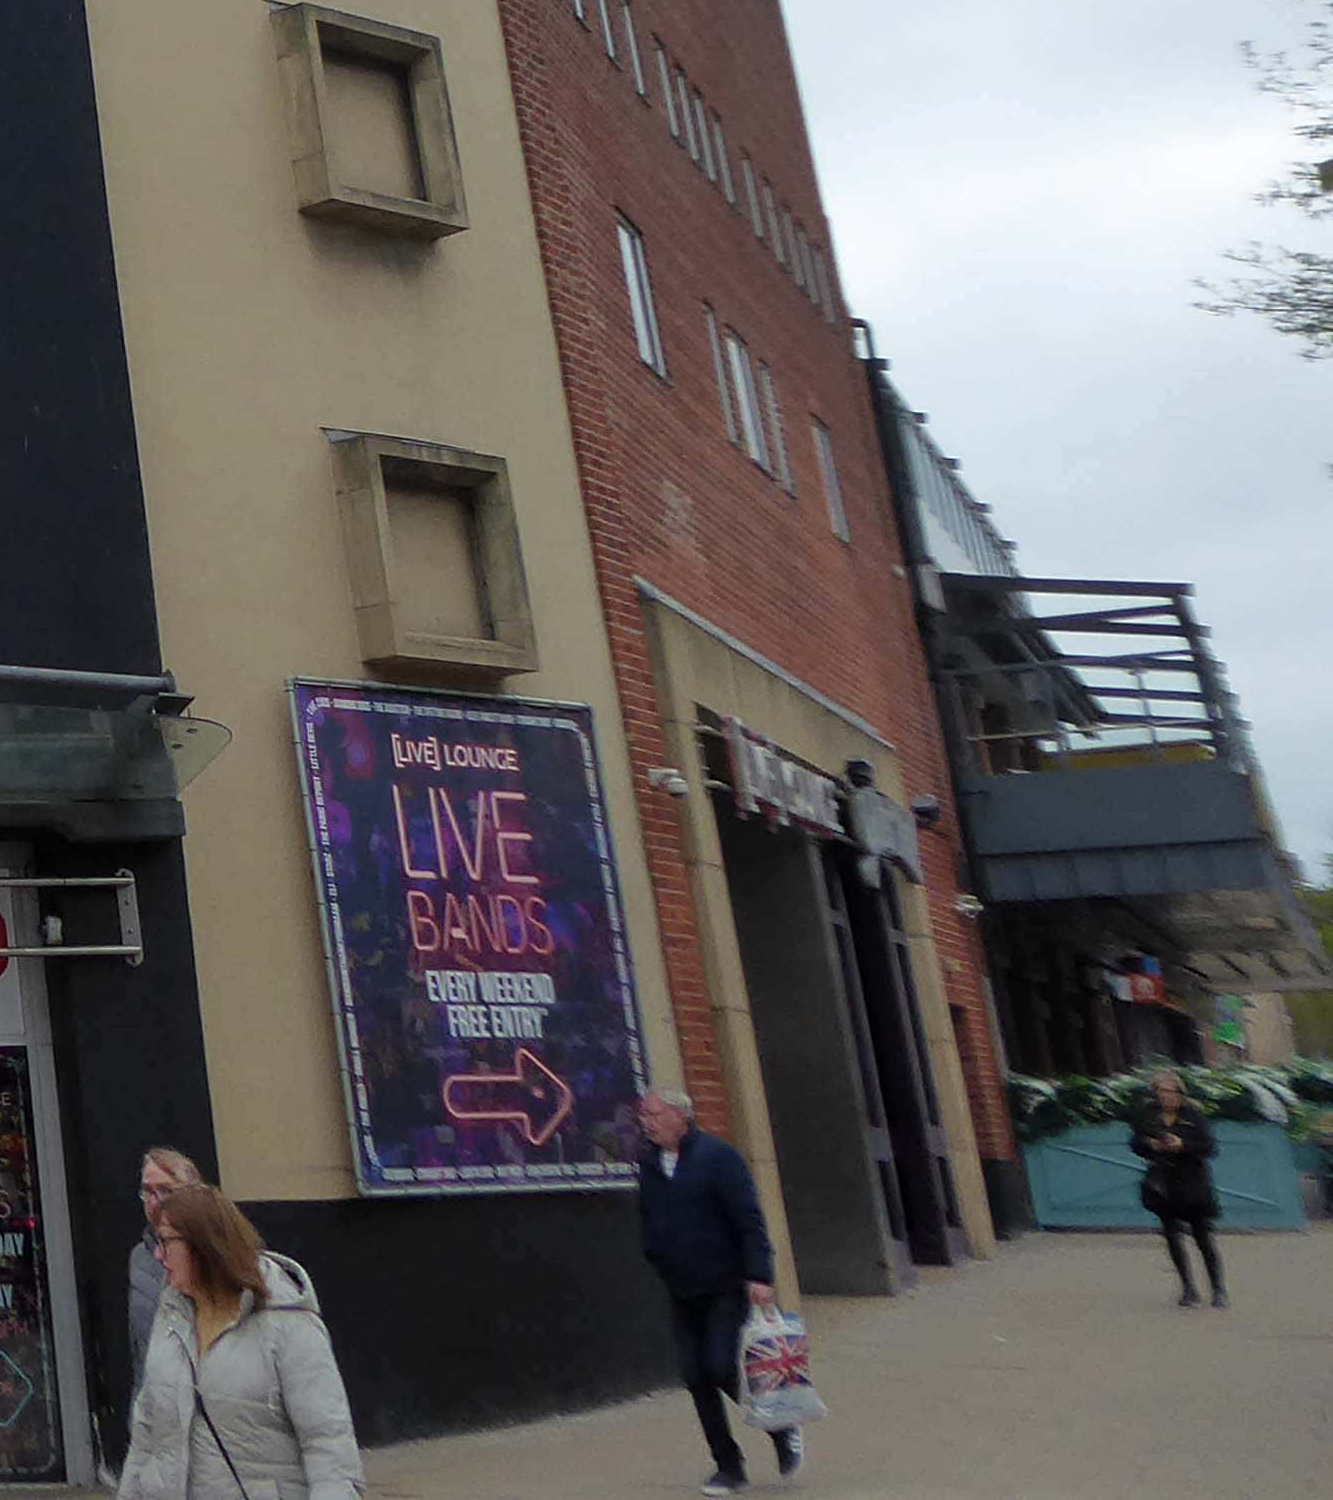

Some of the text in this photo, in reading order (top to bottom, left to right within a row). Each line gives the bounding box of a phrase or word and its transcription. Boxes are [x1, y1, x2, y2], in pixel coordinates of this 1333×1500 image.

[444, 744, 520, 771] LOUNGE
[392, 785, 540, 884] LIVE
[406, 891, 555, 956] BANDS
[425, 970, 557, 1005] EVERY WEEKEND
[446, 1004, 550, 1039] FREE ENTRY
